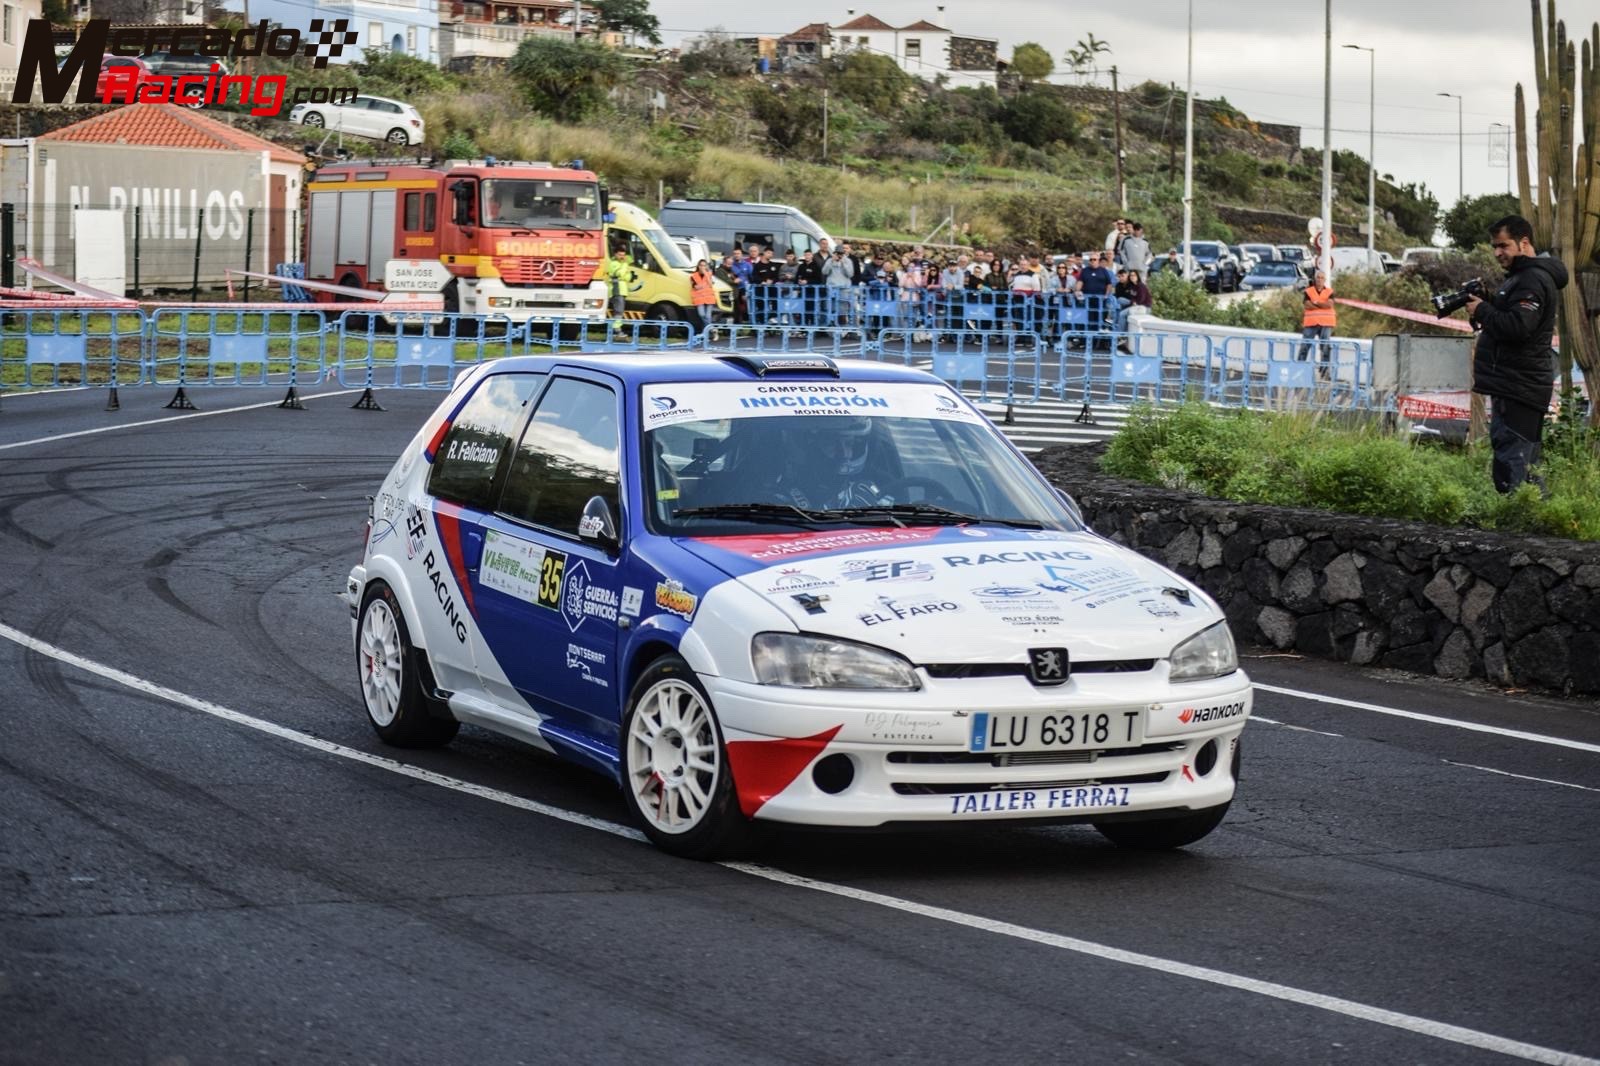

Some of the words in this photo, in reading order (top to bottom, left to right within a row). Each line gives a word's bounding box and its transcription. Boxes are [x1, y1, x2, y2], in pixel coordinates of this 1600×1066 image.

[496, 240, 599, 258] BOMBEROS
[396, 268, 412, 277] SAN
[390, 280, 415, 289] SANTA
[417, 281, 438, 289] CRUZ
[757, 386, 857, 394] CAMPEONATO
[739, 394, 890, 409] INICIACIÓN
[793, 408, 852, 416] MONTAÑA
[648, 408, 695, 421] deportes
[447, 440, 458, 459] R.
[458, 441, 498, 464] Feliciano
[768, 531, 893, 549] TRANSPORTES
[865, 560, 914, 582] EF
[942, 551, 1093, 568] RACING
[540, 556, 564, 604] 35
[423, 550, 468, 644] RACING
[584, 585, 616, 606] GUERRA
[583, 601, 618, 622] SERVICIOS
[860, 612, 892, 627] EL
[886, 600, 958, 620] FARO
[567, 643, 606, 665] MONTSERRAT
[990, 716, 1028, 747] LU
[1040, 711, 1110, 746] 6318
[1123, 710, 1140, 743] T
[949, 791, 1037, 815] TALLER
[1048, 786, 1130, 809] FERRAZ
